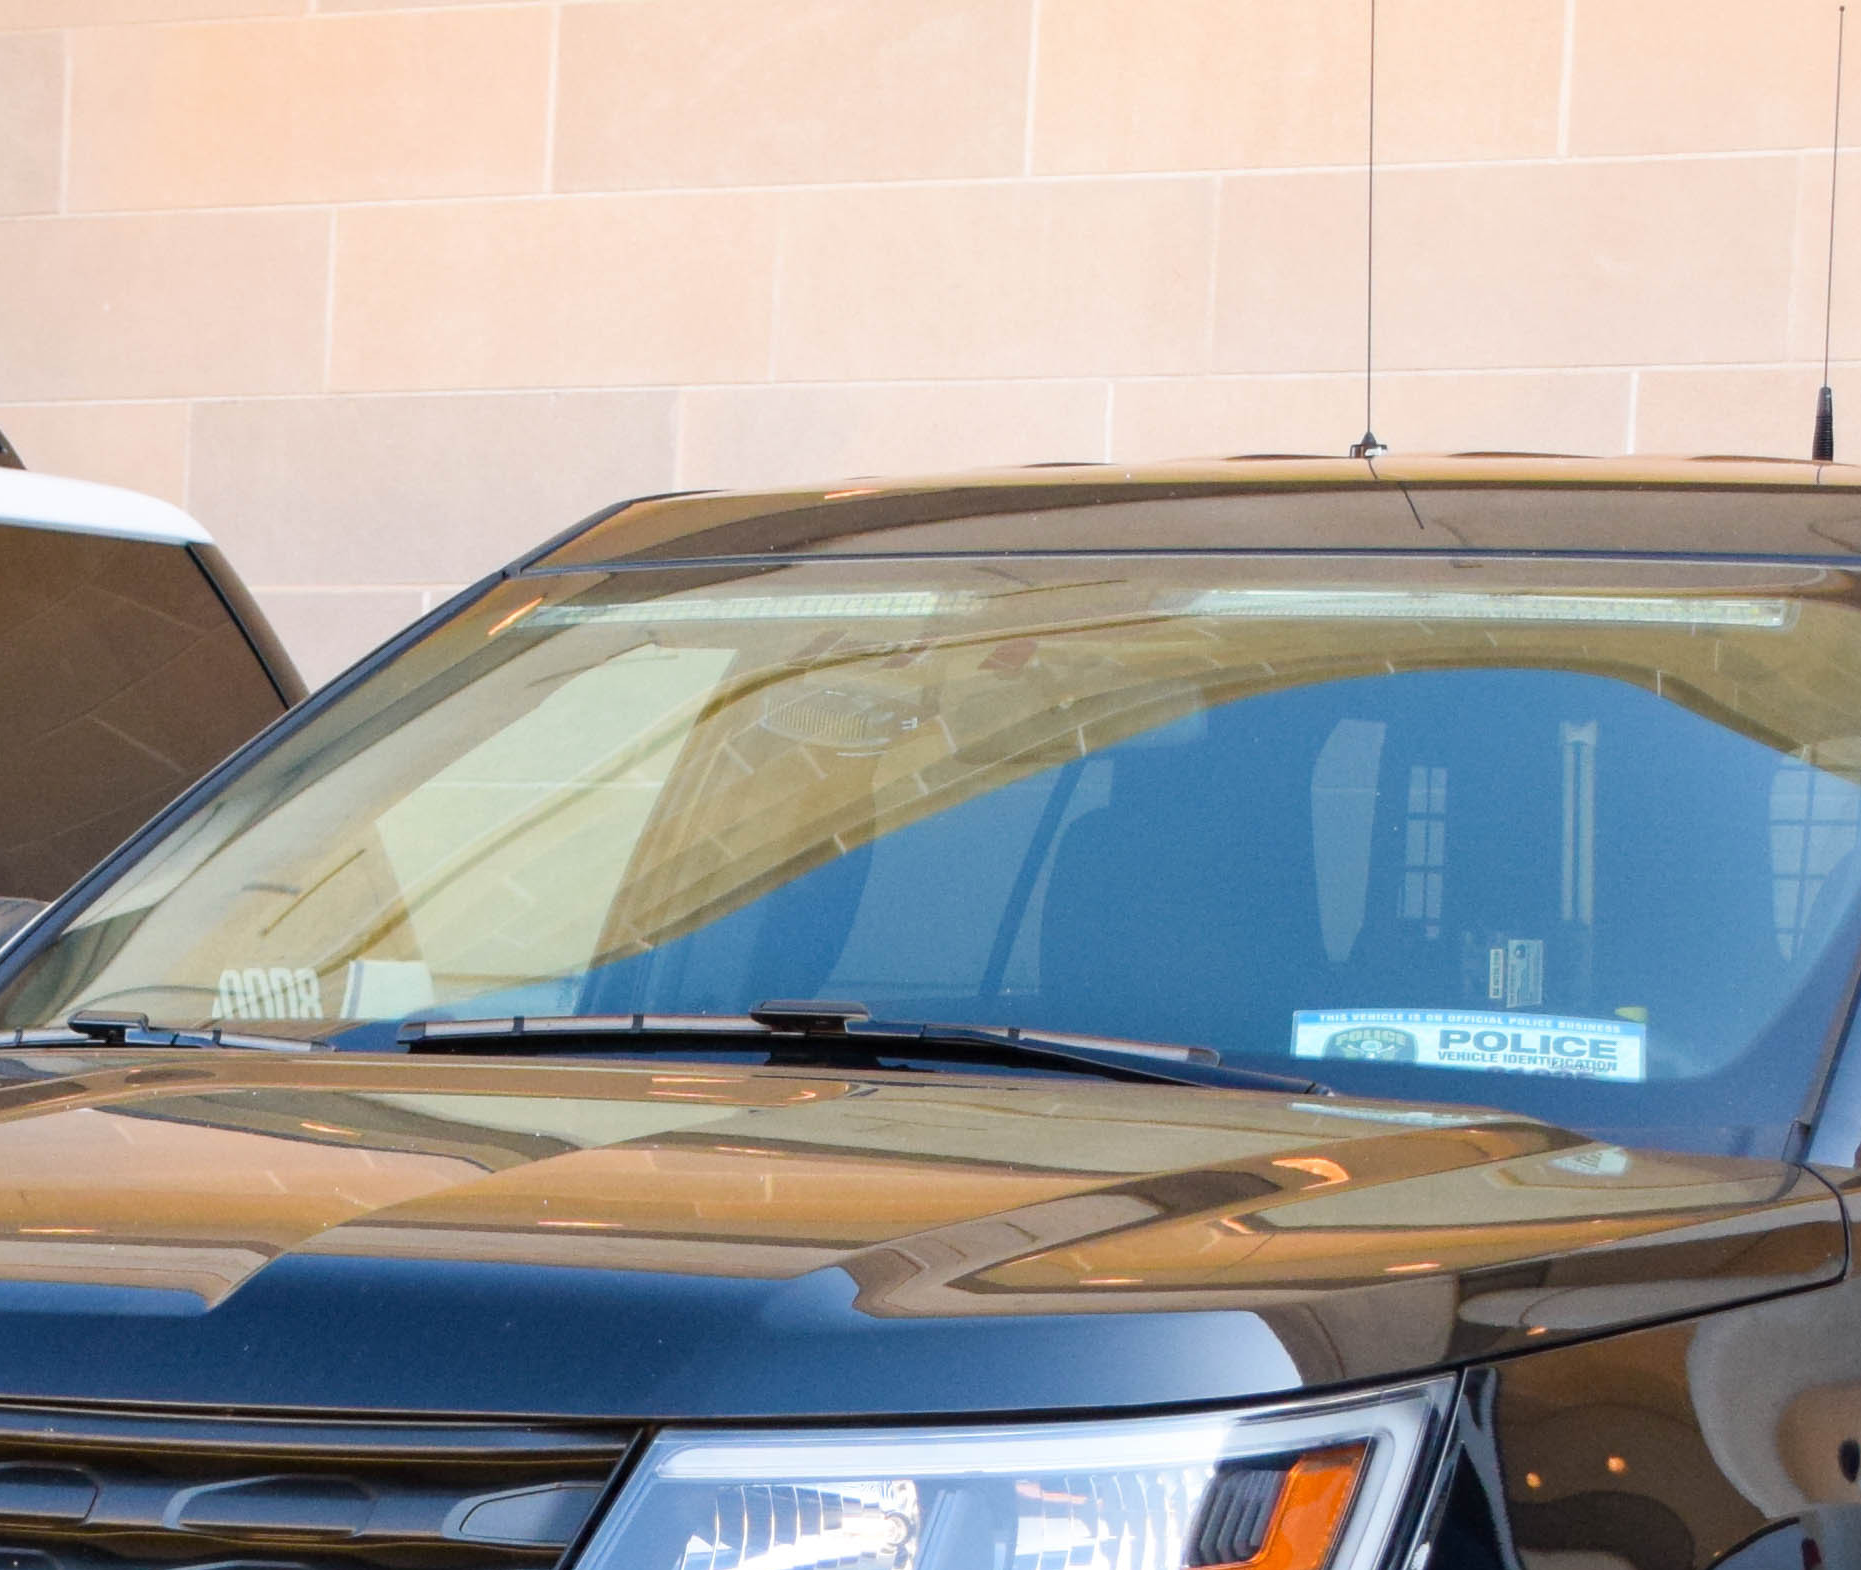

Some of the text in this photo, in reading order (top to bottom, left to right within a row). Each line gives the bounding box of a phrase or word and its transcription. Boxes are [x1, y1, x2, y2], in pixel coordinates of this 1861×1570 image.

[1320, 1013, 1348, 1023] THIS
[1351, 1012, 1404, 1022] VEHICLE
[1447, 1013, 1504, 1025] OFFICIAL
[1508, 1016, 1553, 1028] POLICE
[1557, 1019, 1621, 1034] BUSINESS
[1335, 1028, 1406, 1046] POLICE
[1439, 1029, 1618, 1060] POLICE
[1437, 1051, 1498, 1063] VEHICLE
[1503, 1053, 1618, 1073] IDENTIFICATION
